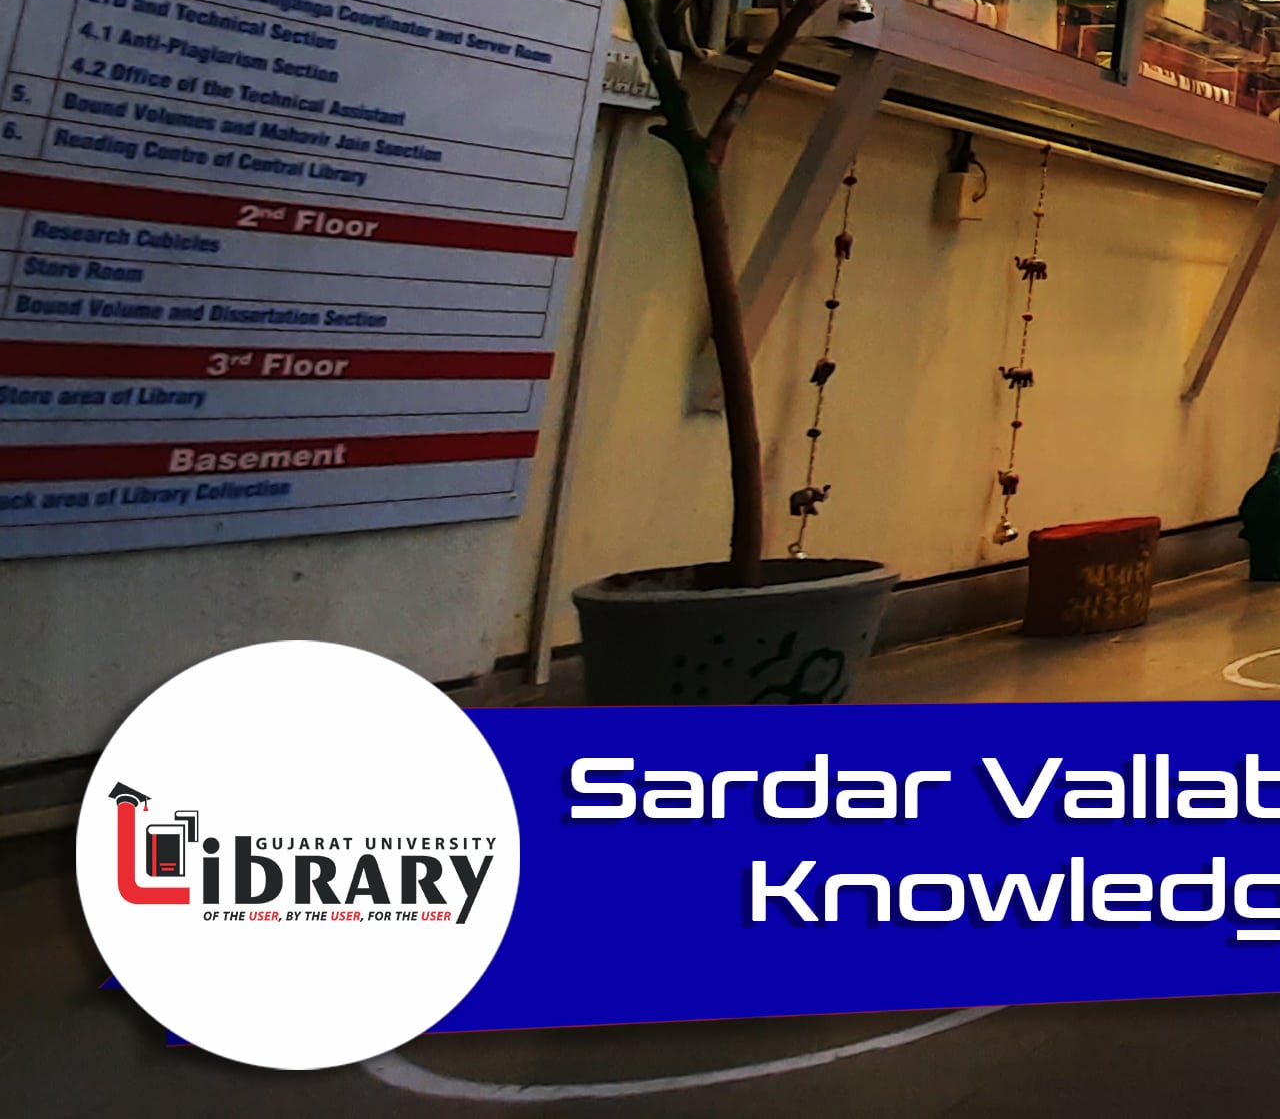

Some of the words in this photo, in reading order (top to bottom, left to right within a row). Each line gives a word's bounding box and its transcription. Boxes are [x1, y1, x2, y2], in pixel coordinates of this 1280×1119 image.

[79, 21, 112, 41] 4.1
[118, 29, 267, 70] Anti-Plagiarism
[272, 57, 338, 83] Section
[32, 220, 129, 244] Research
[135, 229, 219, 252] Cubicles
[237, 204, 285, 226] 2nd
[294, 210, 377, 236] Floor
[206, 352, 252, 375] 3rd
[262, 353, 348, 376] Floor
[169, 444, 344, 471] Basement
